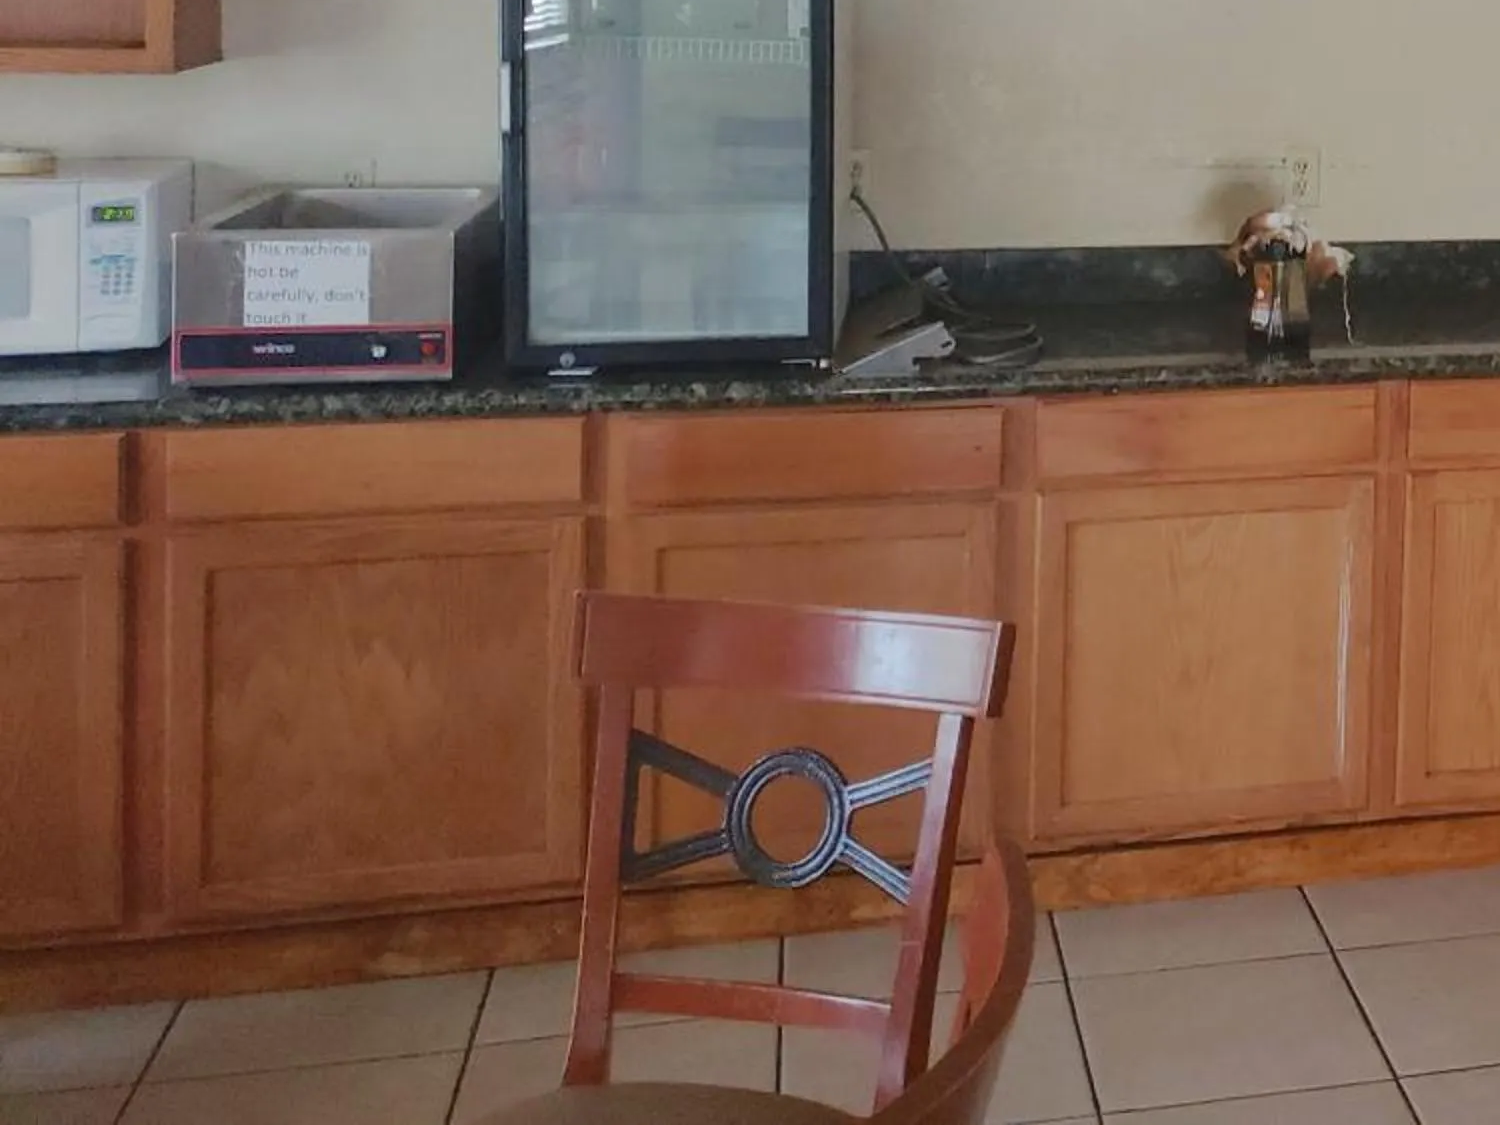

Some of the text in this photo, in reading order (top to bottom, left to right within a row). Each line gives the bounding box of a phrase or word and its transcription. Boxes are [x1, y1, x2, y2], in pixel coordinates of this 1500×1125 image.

[250, 242, 368, 256] This machine is
